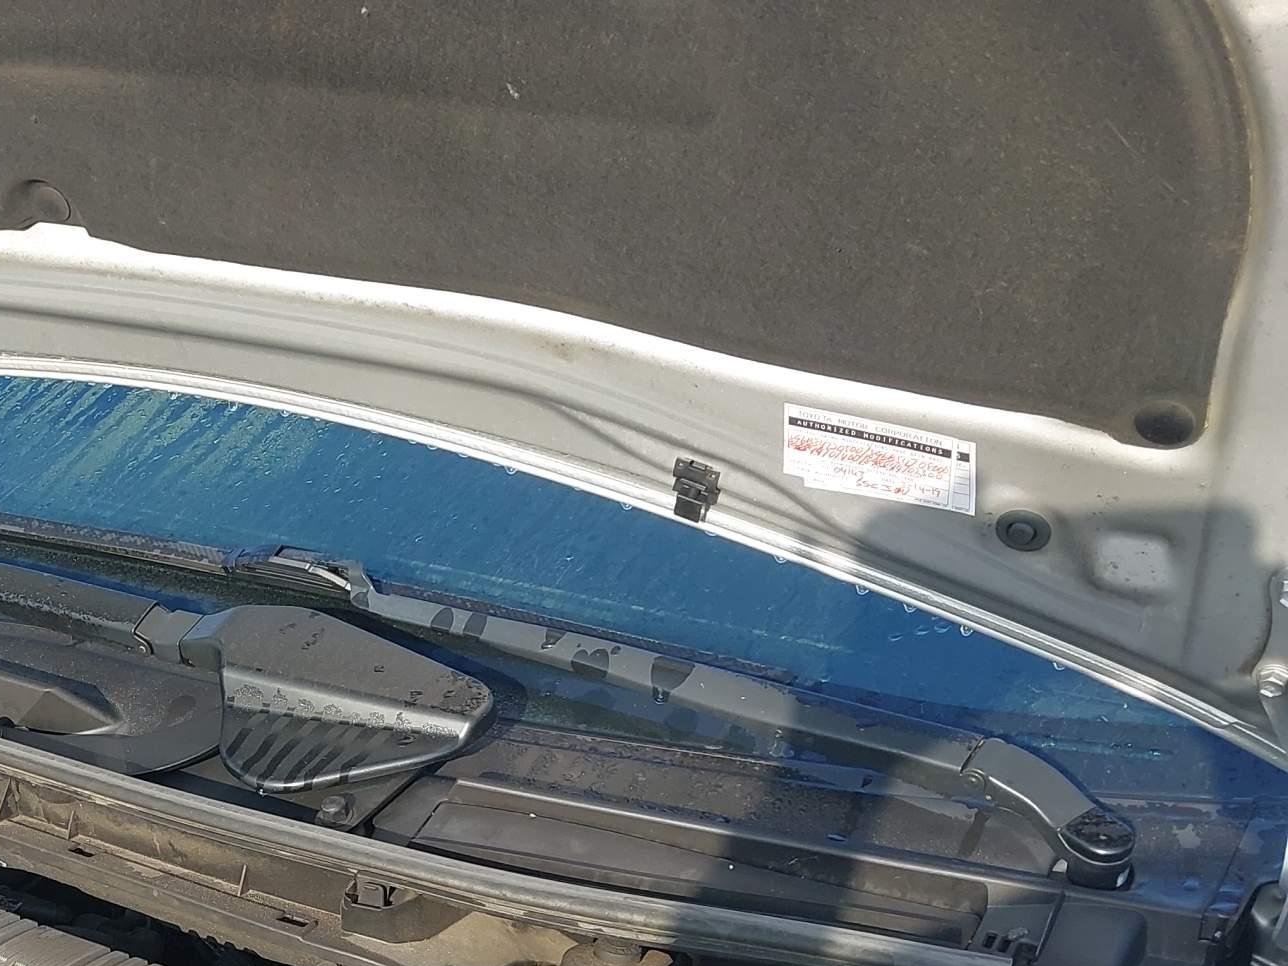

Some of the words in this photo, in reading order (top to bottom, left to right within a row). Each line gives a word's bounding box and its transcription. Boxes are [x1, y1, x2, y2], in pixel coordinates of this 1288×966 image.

[796, 419, 857, 437] AUTHORIZED
[863, 432, 943, 456] MODIFICATIONS
[875, 426, 943, 447] CORPORATION
